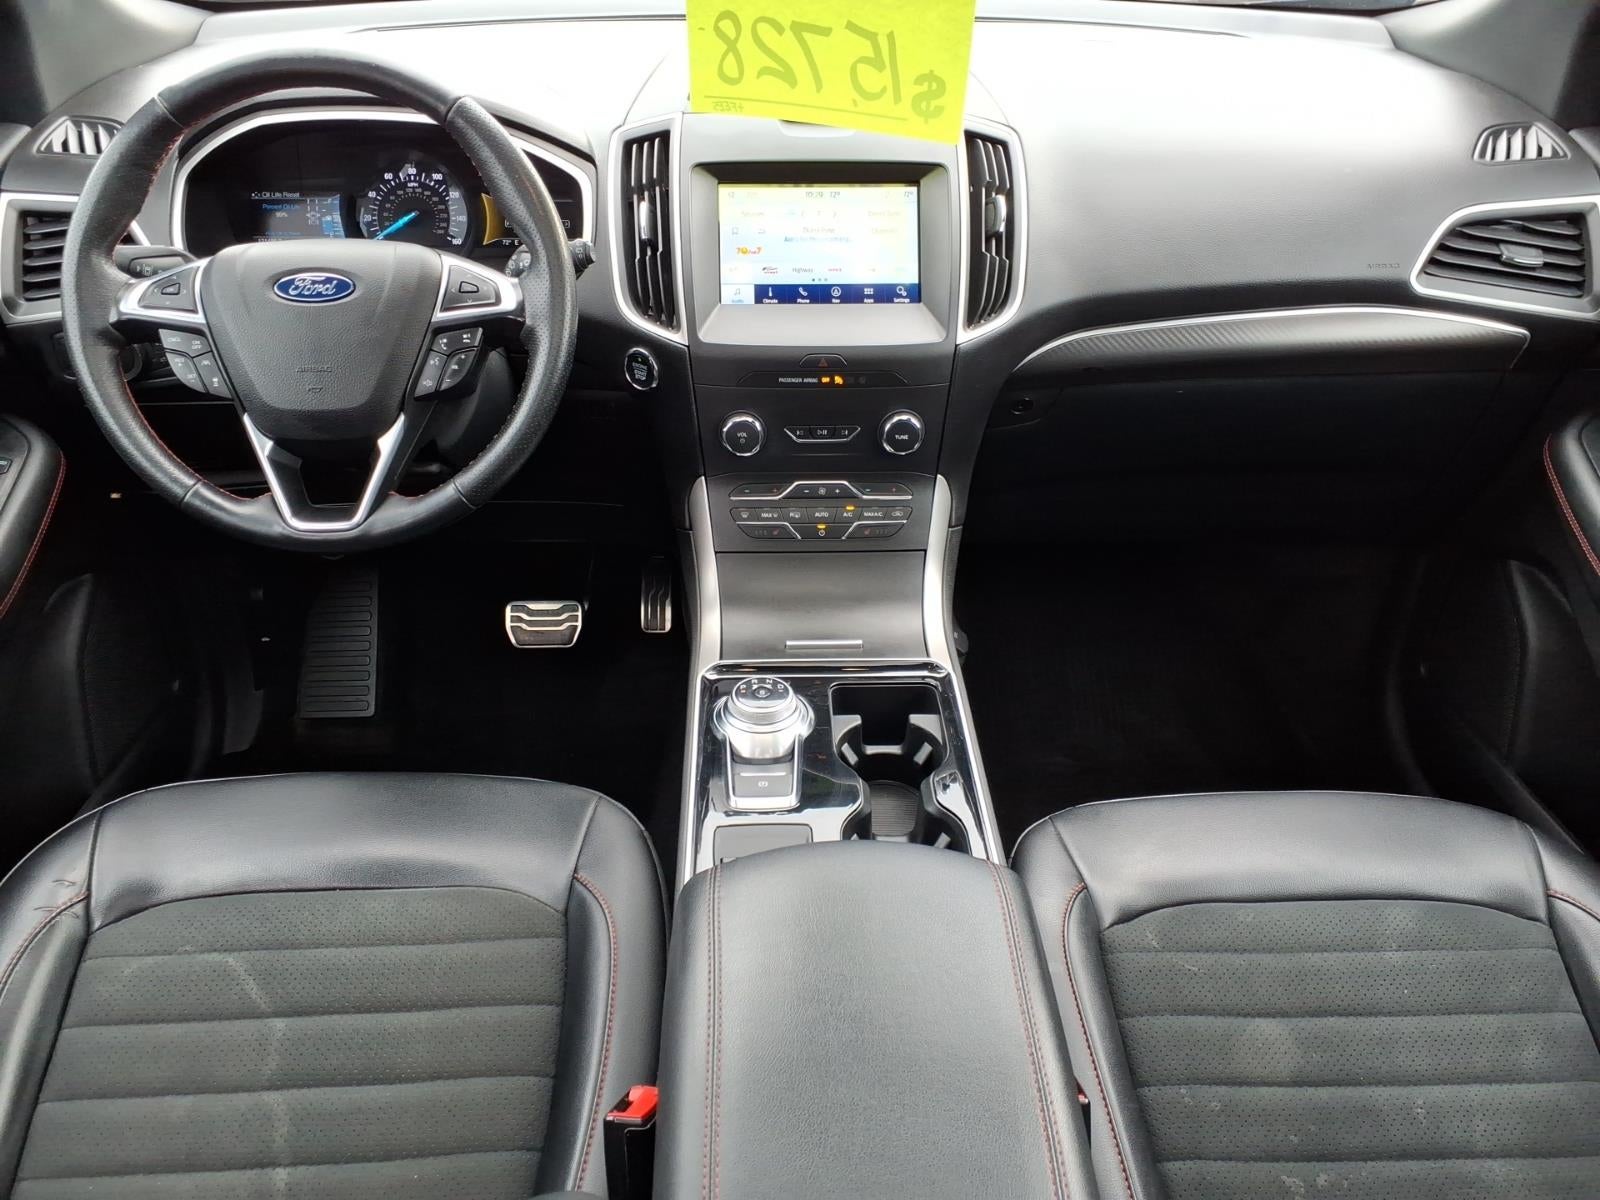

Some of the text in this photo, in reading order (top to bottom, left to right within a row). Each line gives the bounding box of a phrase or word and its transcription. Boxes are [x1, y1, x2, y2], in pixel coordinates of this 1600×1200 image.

[384, 172, 393, 180] 60
[432, 173, 443, 181] 100
[288, 275, 338, 296] Ford
